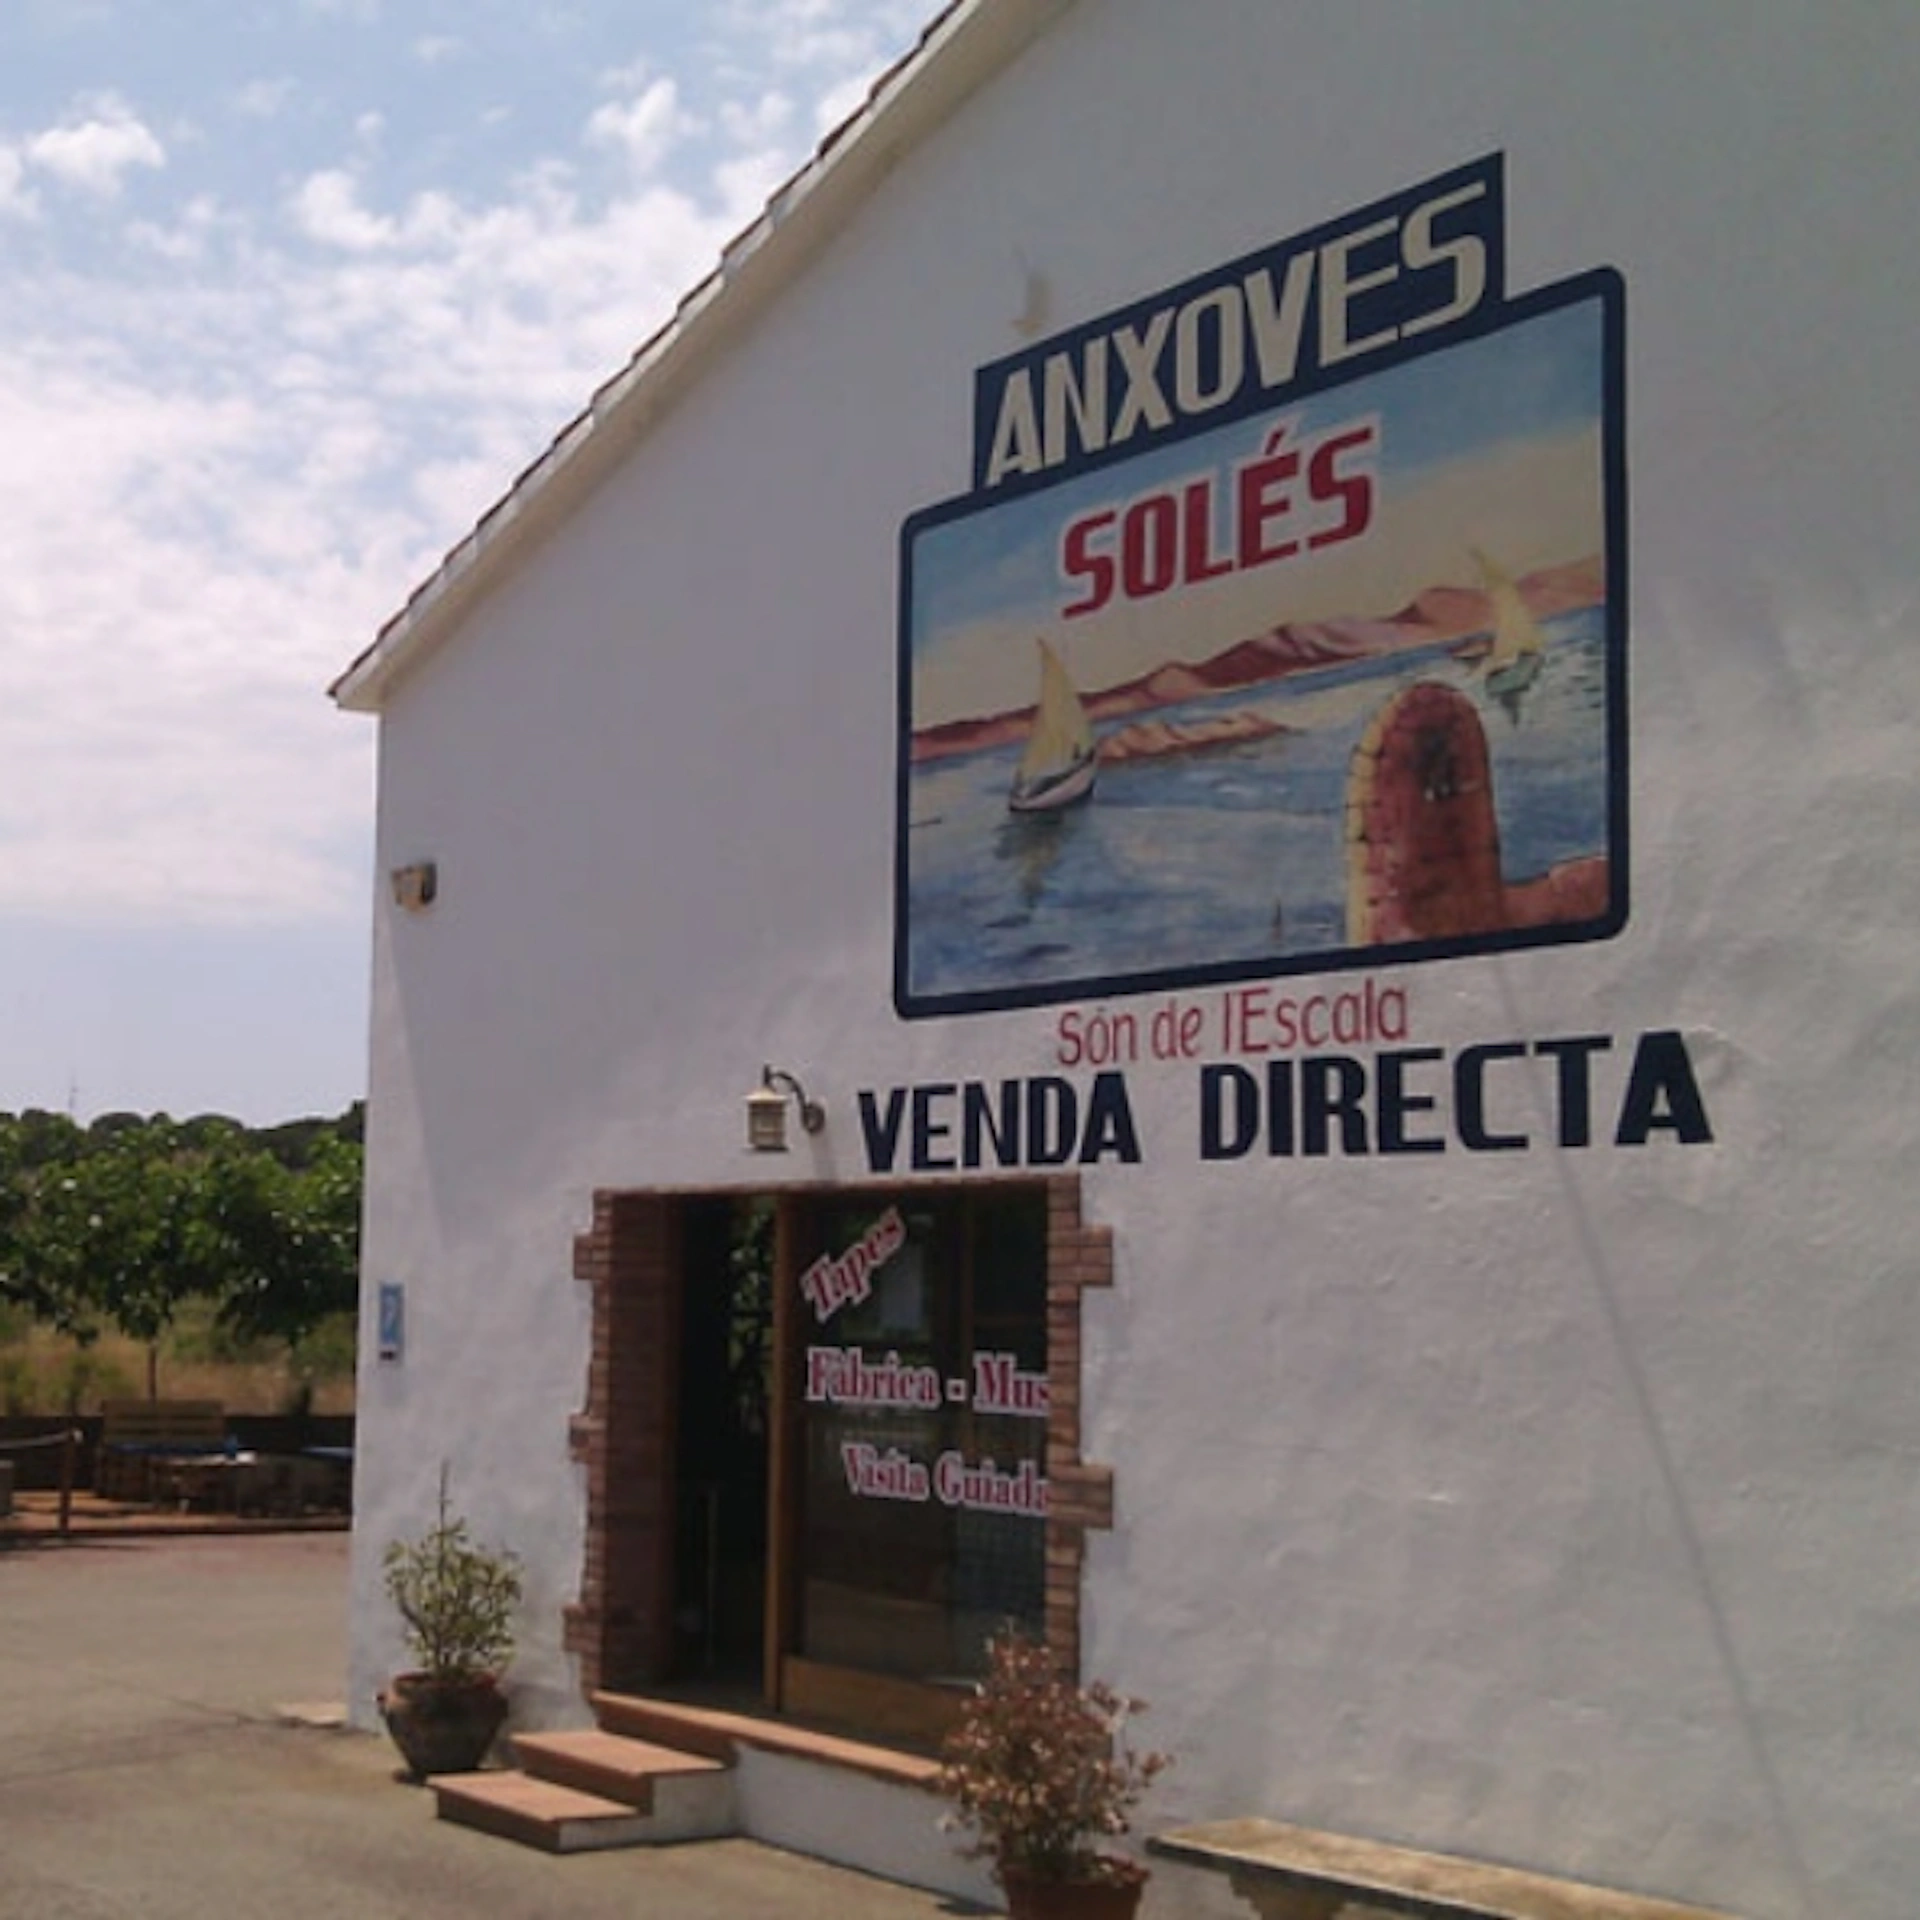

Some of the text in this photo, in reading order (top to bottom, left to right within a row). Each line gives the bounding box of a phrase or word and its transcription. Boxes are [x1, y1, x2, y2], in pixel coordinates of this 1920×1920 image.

[984, 180, 1487, 487] ANXOVES
[1062, 425, 1375, 619] SOLÉS
[1151, 997, 1203, 1061] de
[857, 1030, 1715, 1174] VENDA DIRECTA
[803, 1207, 905, 1322] Tapes
[841, 1443, 930, 1501] Visita
